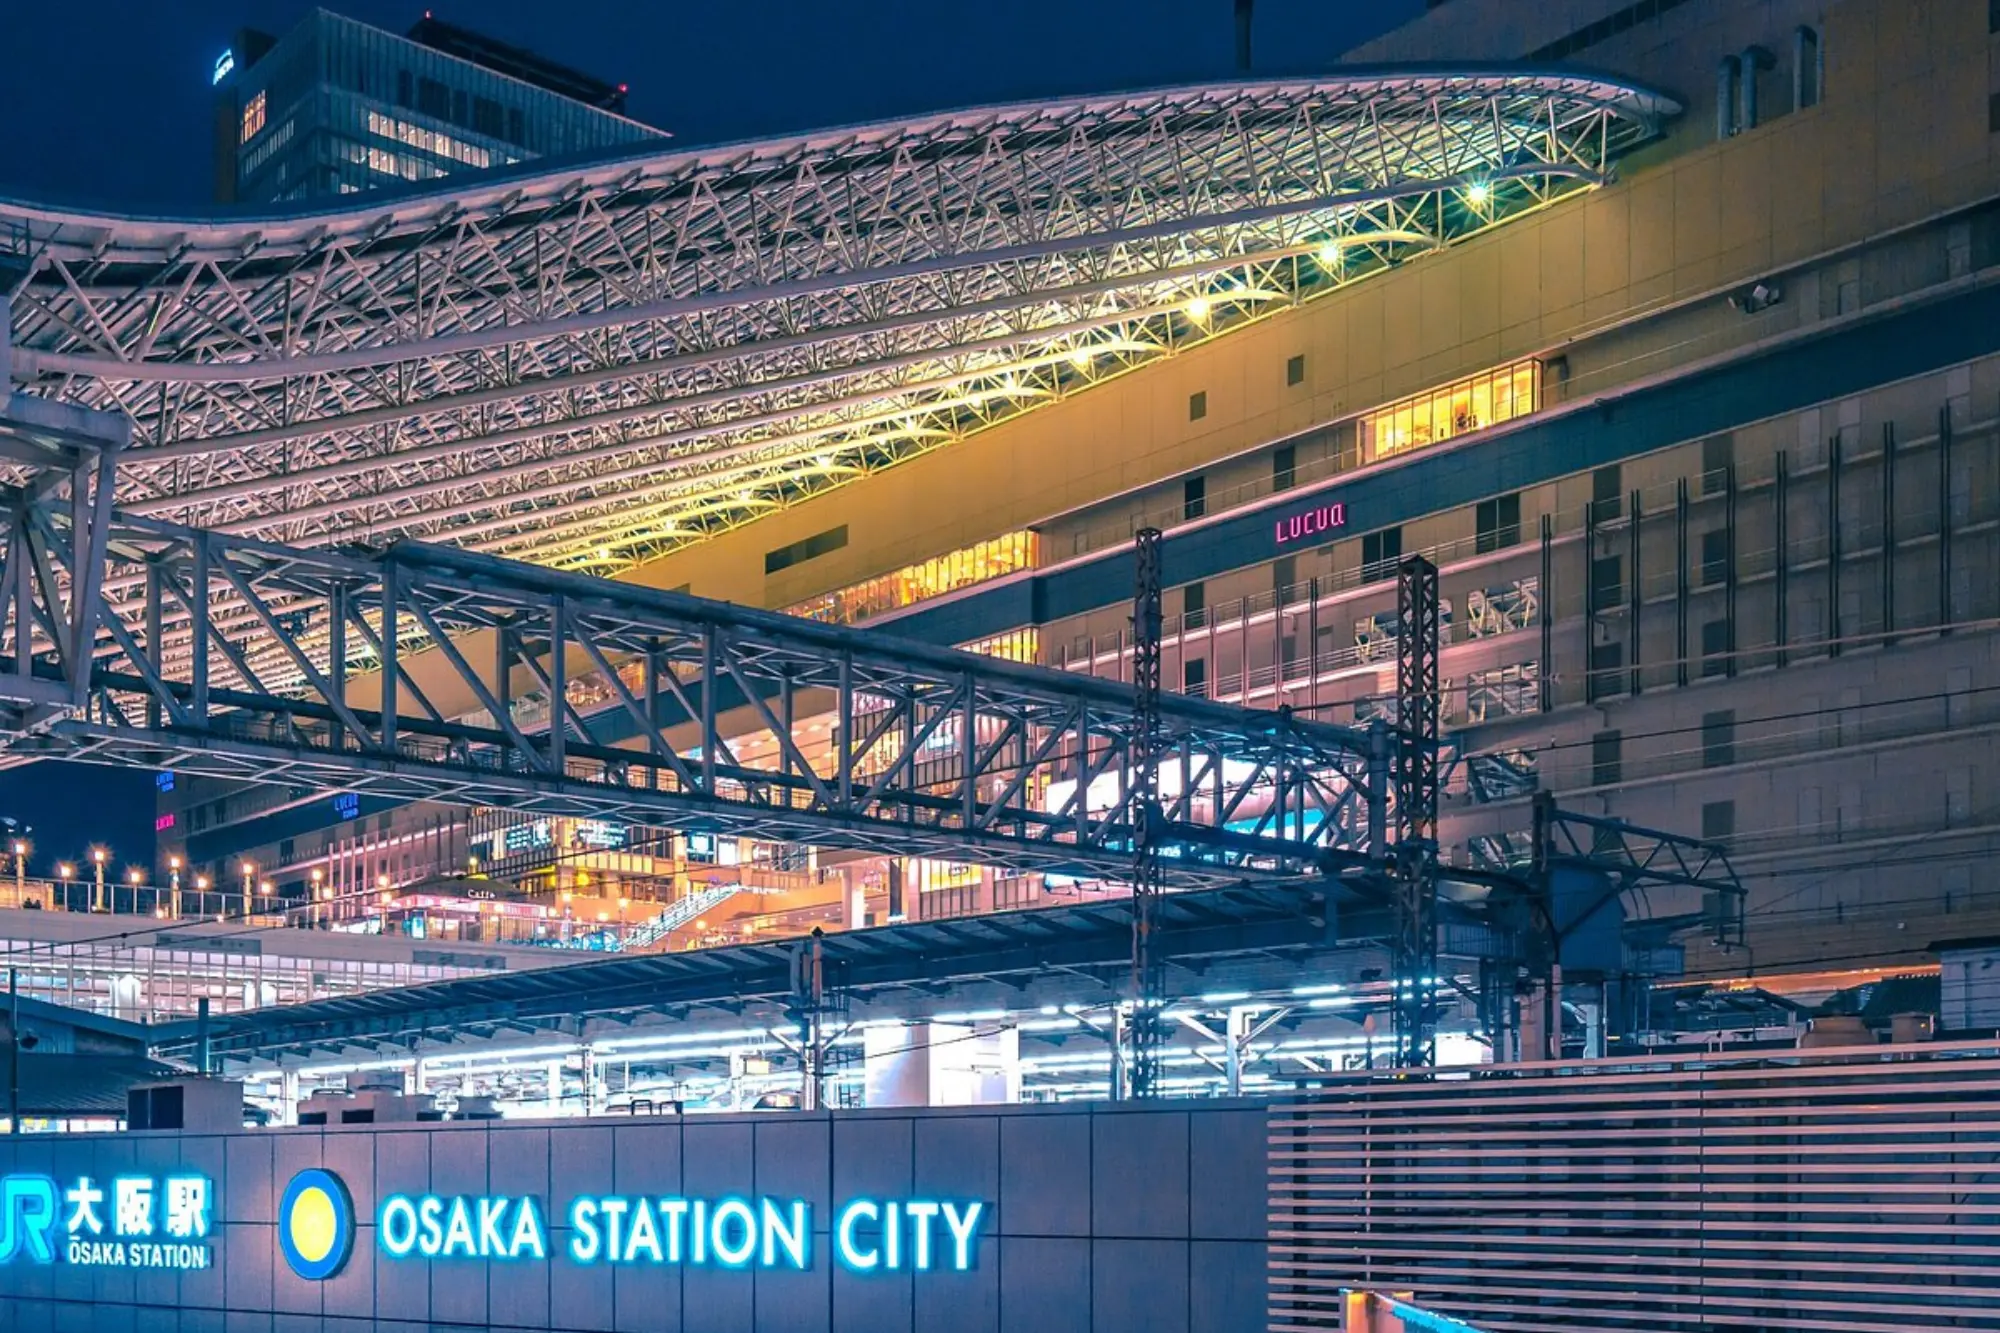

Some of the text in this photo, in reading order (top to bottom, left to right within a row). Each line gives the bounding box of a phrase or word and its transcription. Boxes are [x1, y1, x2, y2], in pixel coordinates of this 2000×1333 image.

[0, 1175, 207, 1262] JR 大阪駅
[129, 1243, 205, 1268] STATION
[381, 1195, 984, 1272] OSAKA STATION CITY
